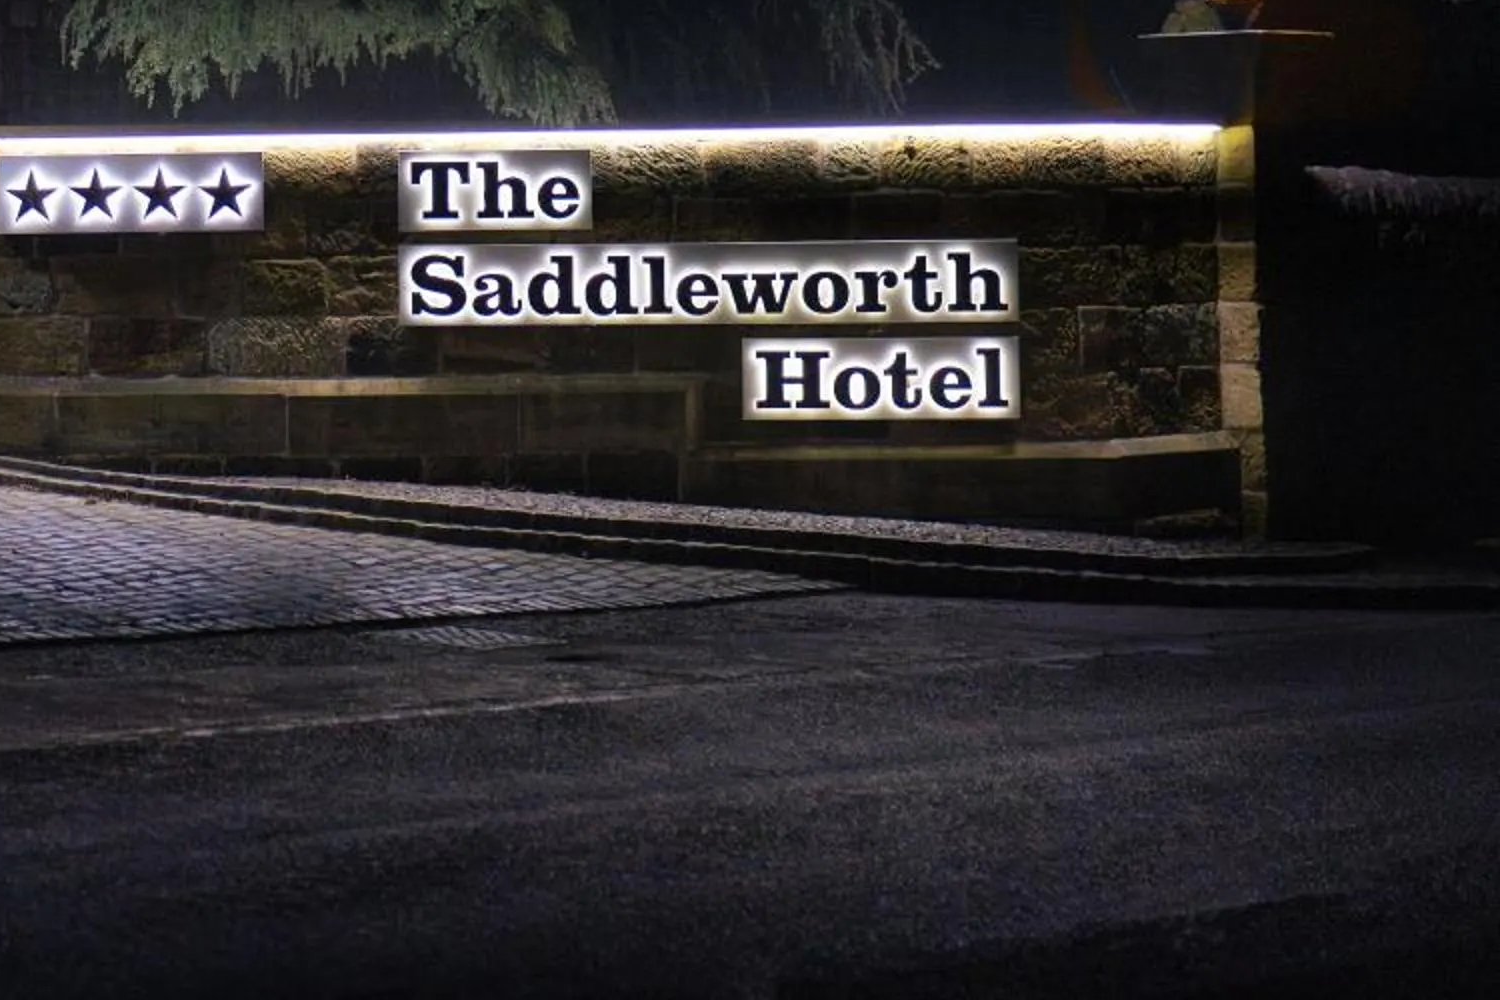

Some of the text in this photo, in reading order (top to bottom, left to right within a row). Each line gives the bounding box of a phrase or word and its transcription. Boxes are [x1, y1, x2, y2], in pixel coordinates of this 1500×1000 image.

[410, 161, 581, 221] The
[409, 252, 1009, 317] Saddleworth
[755, 347, 1009, 410] Hotel
